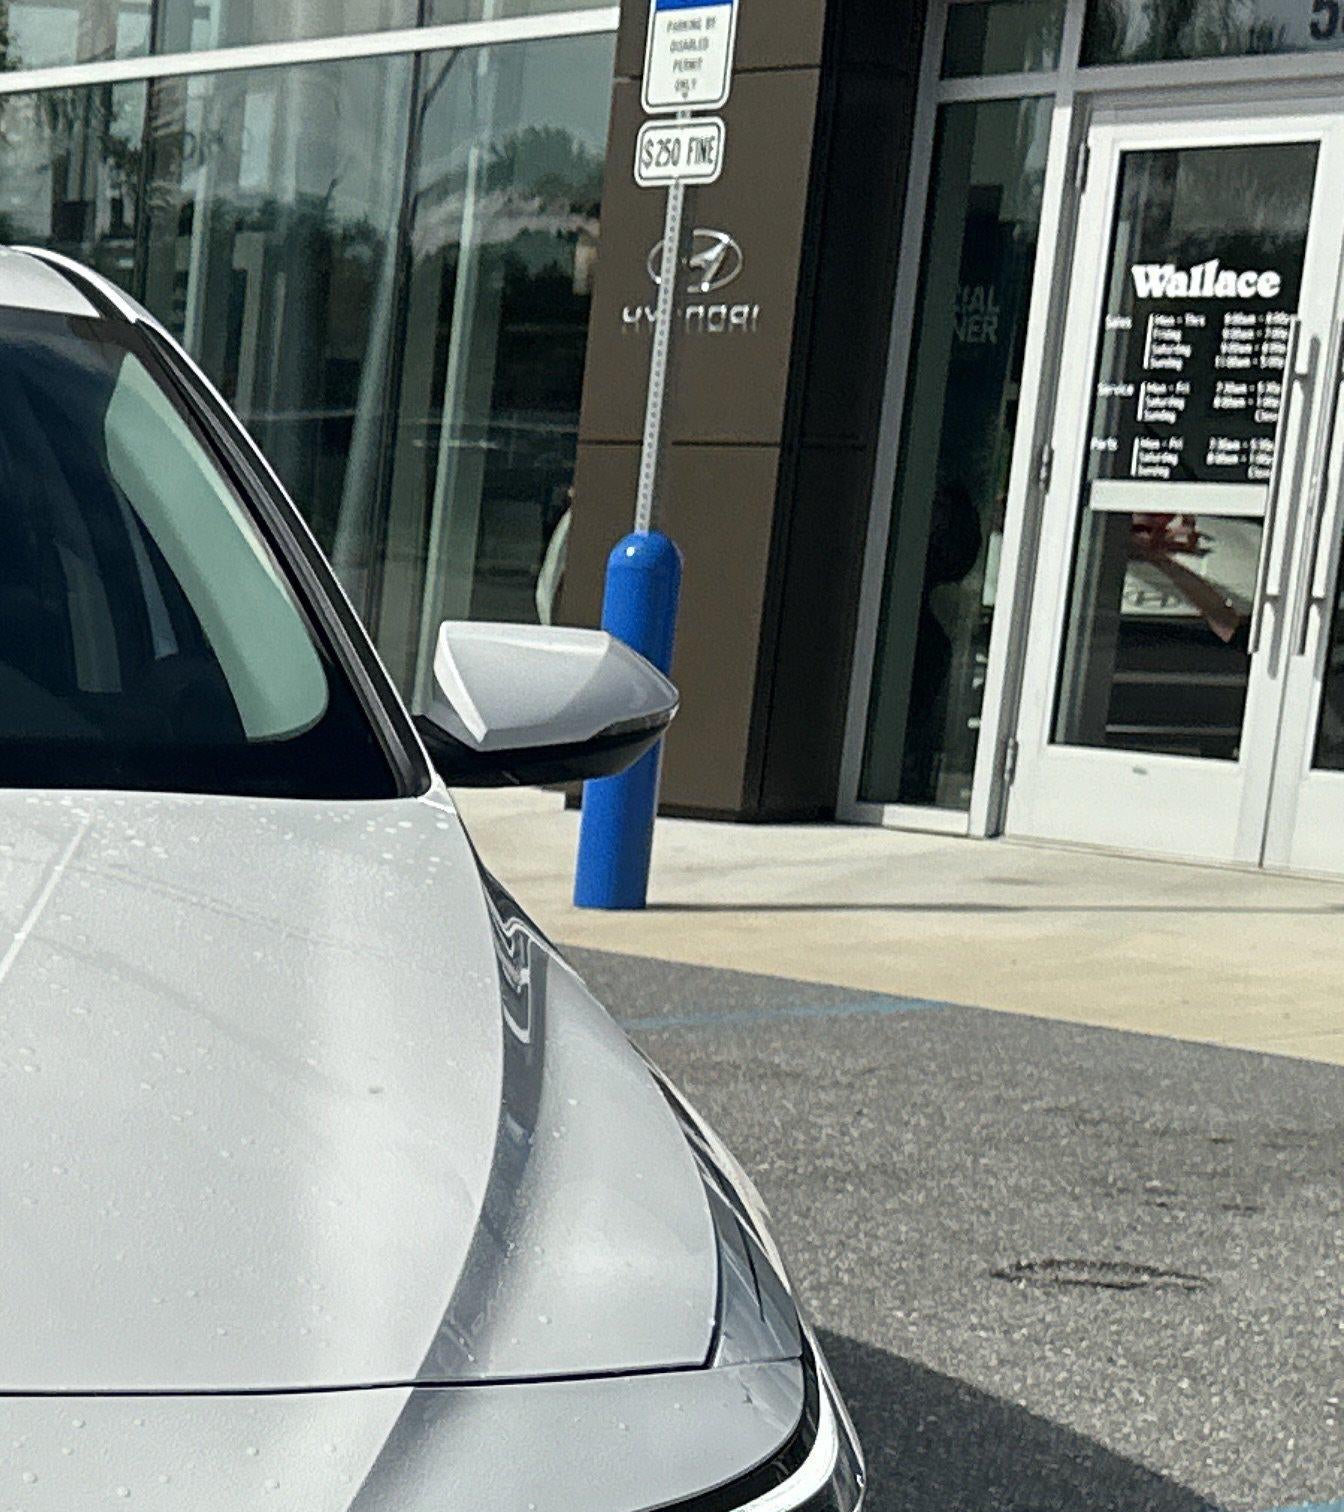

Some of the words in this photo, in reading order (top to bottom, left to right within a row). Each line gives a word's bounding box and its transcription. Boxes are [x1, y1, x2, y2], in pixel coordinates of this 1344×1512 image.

[642, 137, 681, 169] $250
[686, 135, 715, 167] FINE
[1131, 257, 1281, 299] Wallace
[622, 303, 759, 335] HYNDAI
